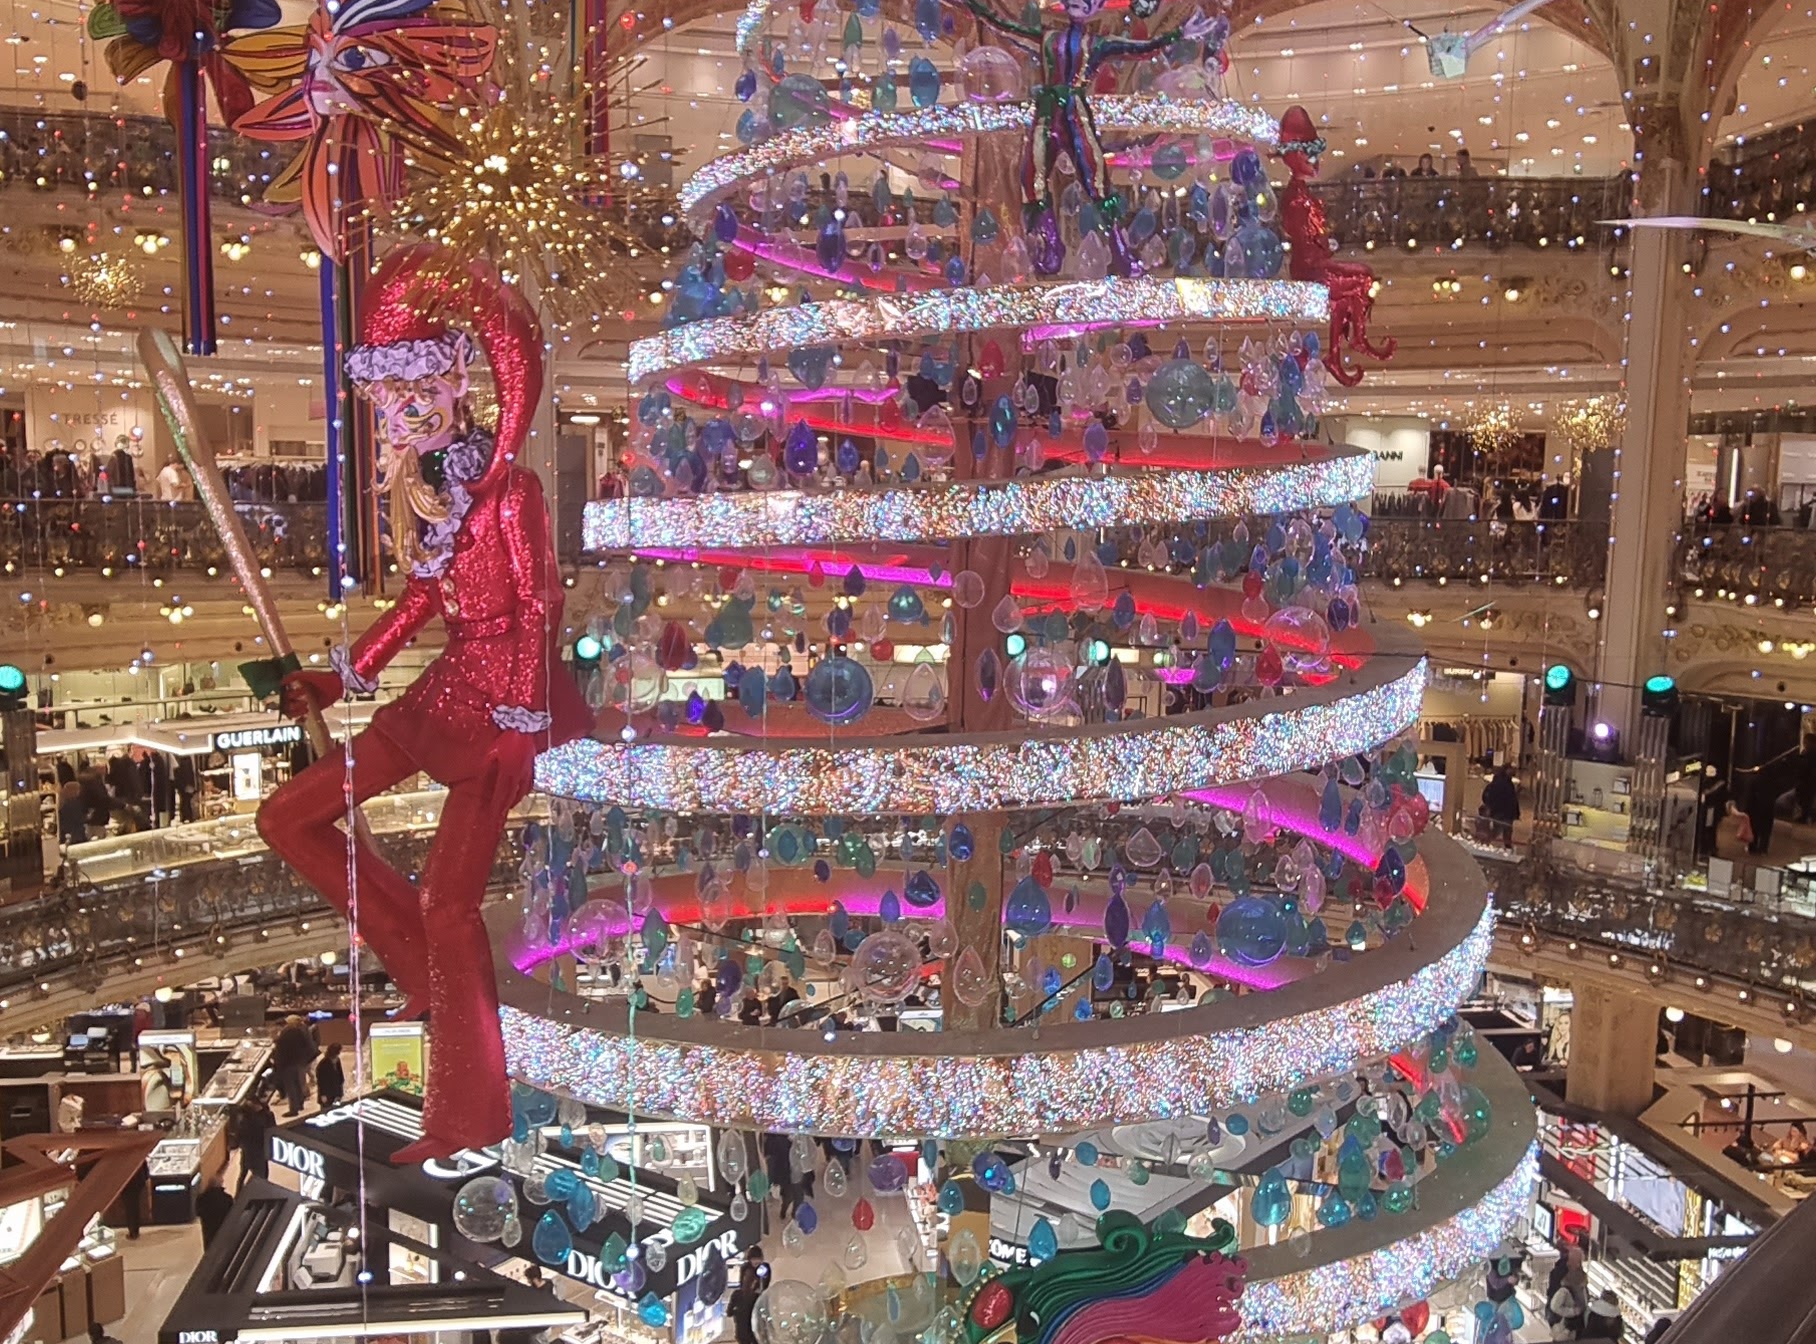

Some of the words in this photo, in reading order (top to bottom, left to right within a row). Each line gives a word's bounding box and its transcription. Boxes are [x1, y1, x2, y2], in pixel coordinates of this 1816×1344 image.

[217, 726, 301, 749] GUERLAIN
[272, 1136, 325, 1178] DIOR
[567, 1248, 637, 1299] DIO
[179, 1331, 218, 1344] DIOR
